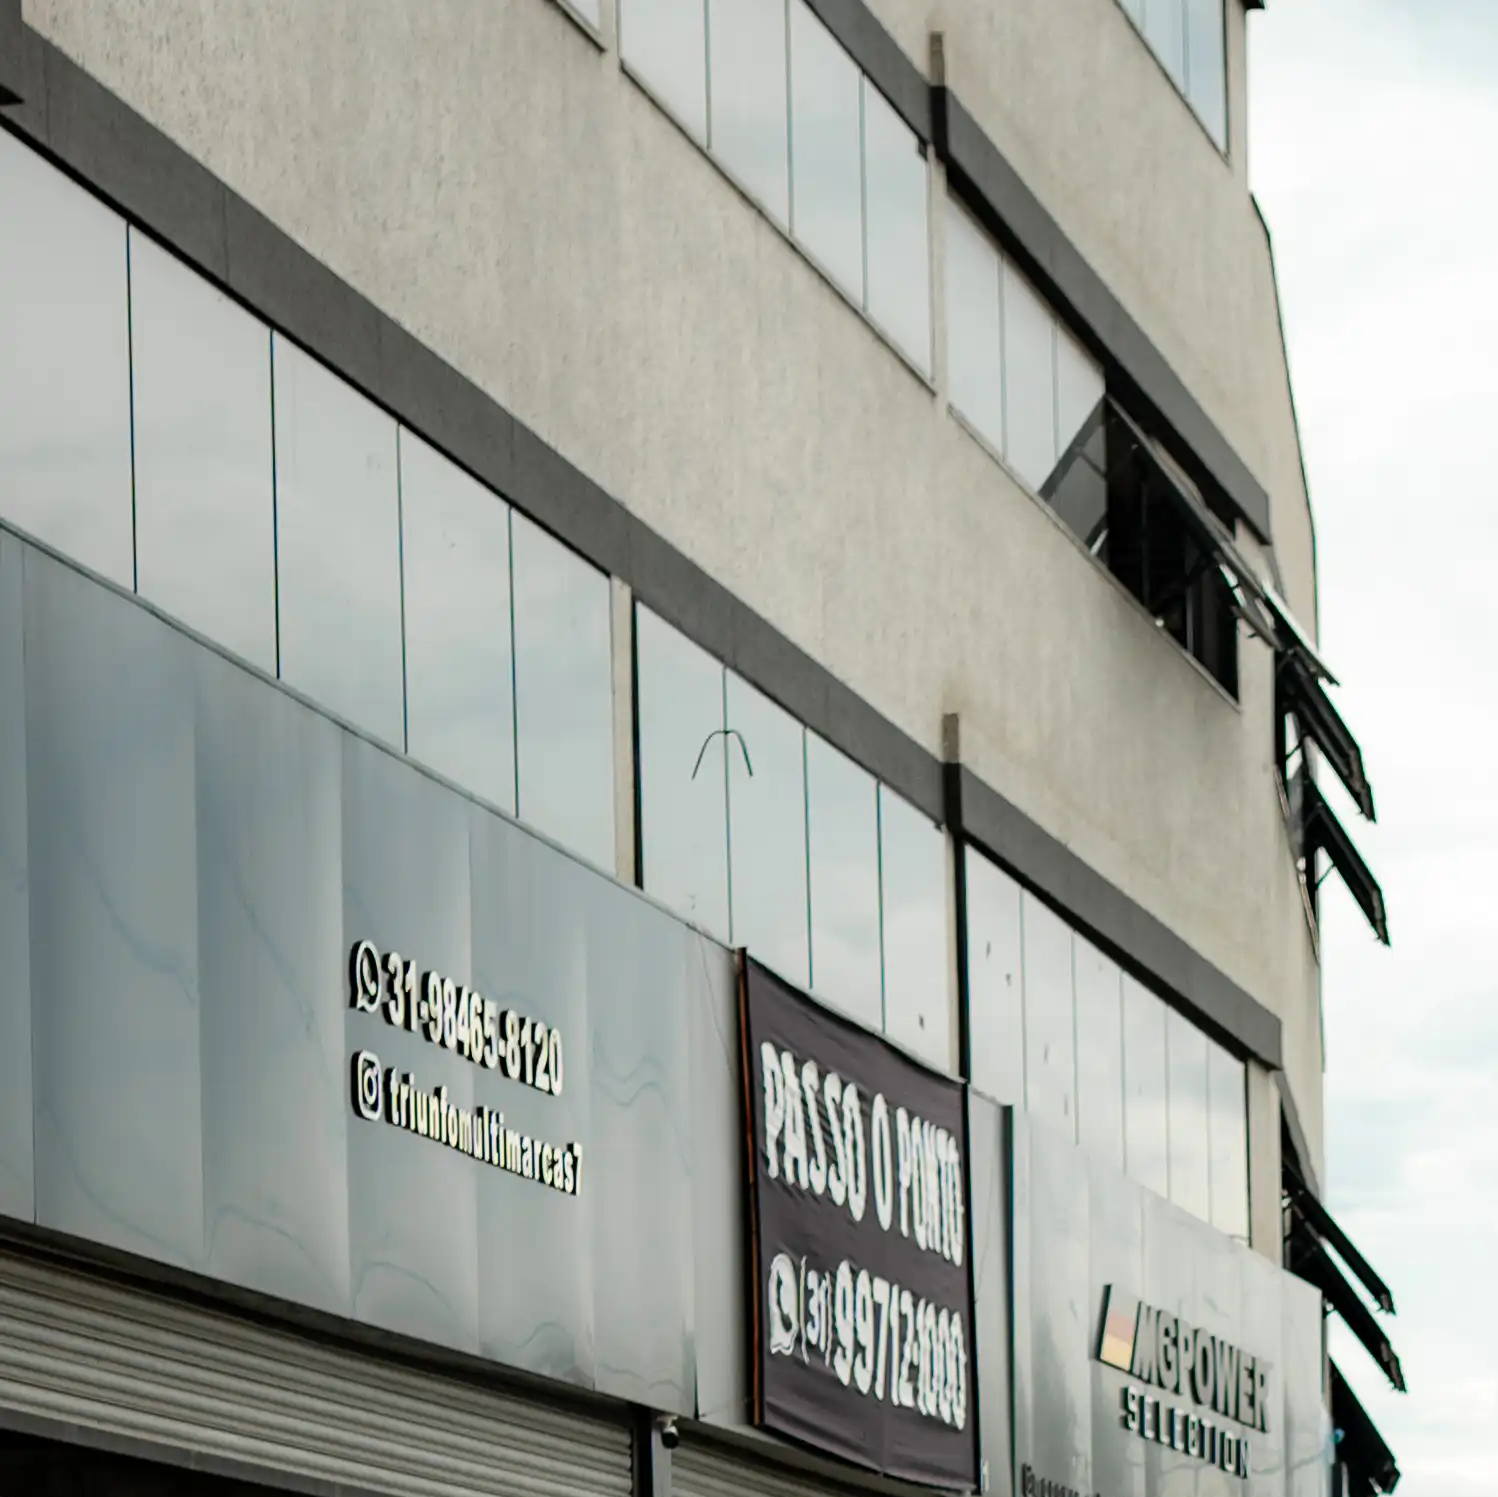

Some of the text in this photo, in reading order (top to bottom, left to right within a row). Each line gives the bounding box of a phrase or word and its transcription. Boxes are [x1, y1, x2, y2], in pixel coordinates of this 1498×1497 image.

[384, 951, 563, 1097] 31-98465-8120
[387, 1064, 583, 1196] triunfomultimarcas7
[760, 1041, 964, 1267] PASSO O PONTO
[1122, 1384, 1249, 1480] SELECTION
